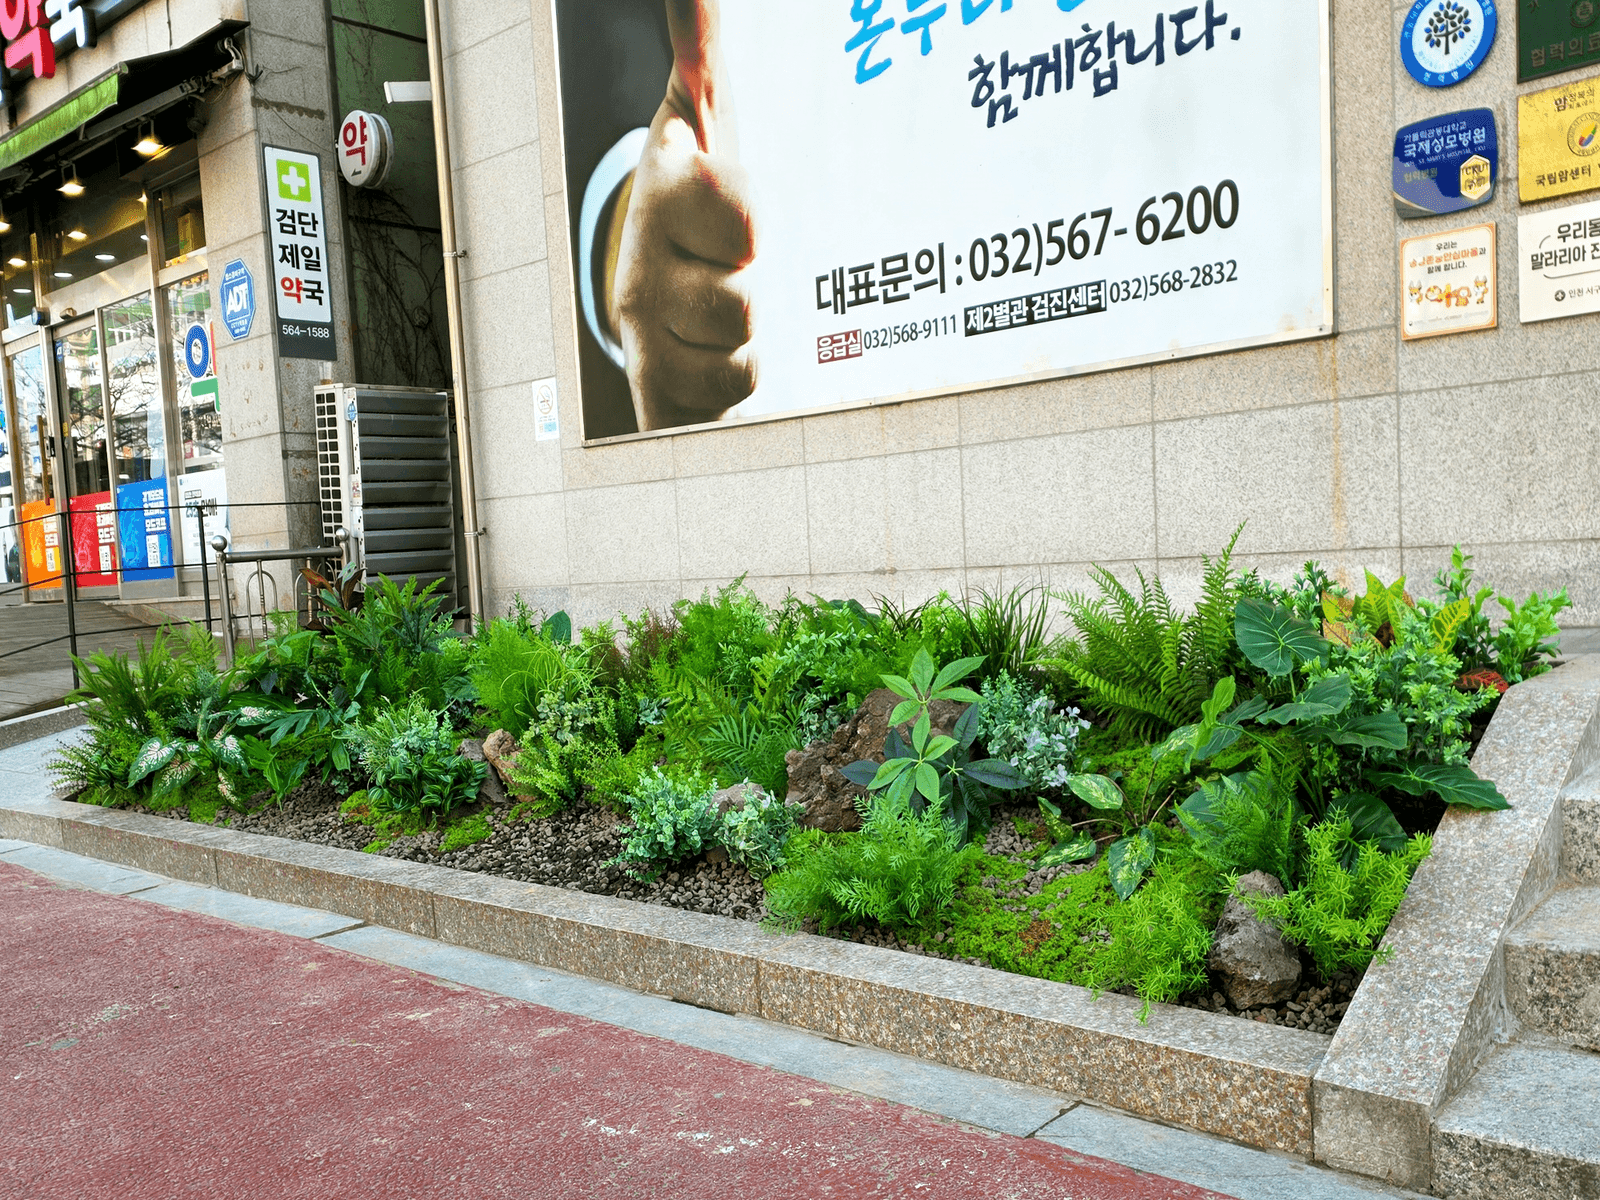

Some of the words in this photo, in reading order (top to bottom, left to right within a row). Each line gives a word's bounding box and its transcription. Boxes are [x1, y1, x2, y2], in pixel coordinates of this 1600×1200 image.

[343, 115, 369, 166] 약
[1404, 127, 1486, 158] 국제성모병원
[1536, 164, 1591, 187] 국립암센터
[276, 209, 319, 238] 검단
[279, 244, 322, 272] 제일
[1436, 241, 1457, 251] 우리는
[1531, 244, 1587, 271] 말라리아
[227, 282, 248, 316] ADT
[281, 277, 324, 306] 약국
[1568, 288, 1584, 298] 인천
[818, 334, 862, 361] 응급실
[864, 315, 957, 350] 032)568-9111
[966, 304, 1028, 333] 제2별관
[1031, 282, 1107, 321] 검진센터
[1110, 260, 1238, 310] 032)568-2832
[282, 325, 330, 338] 564-1588
